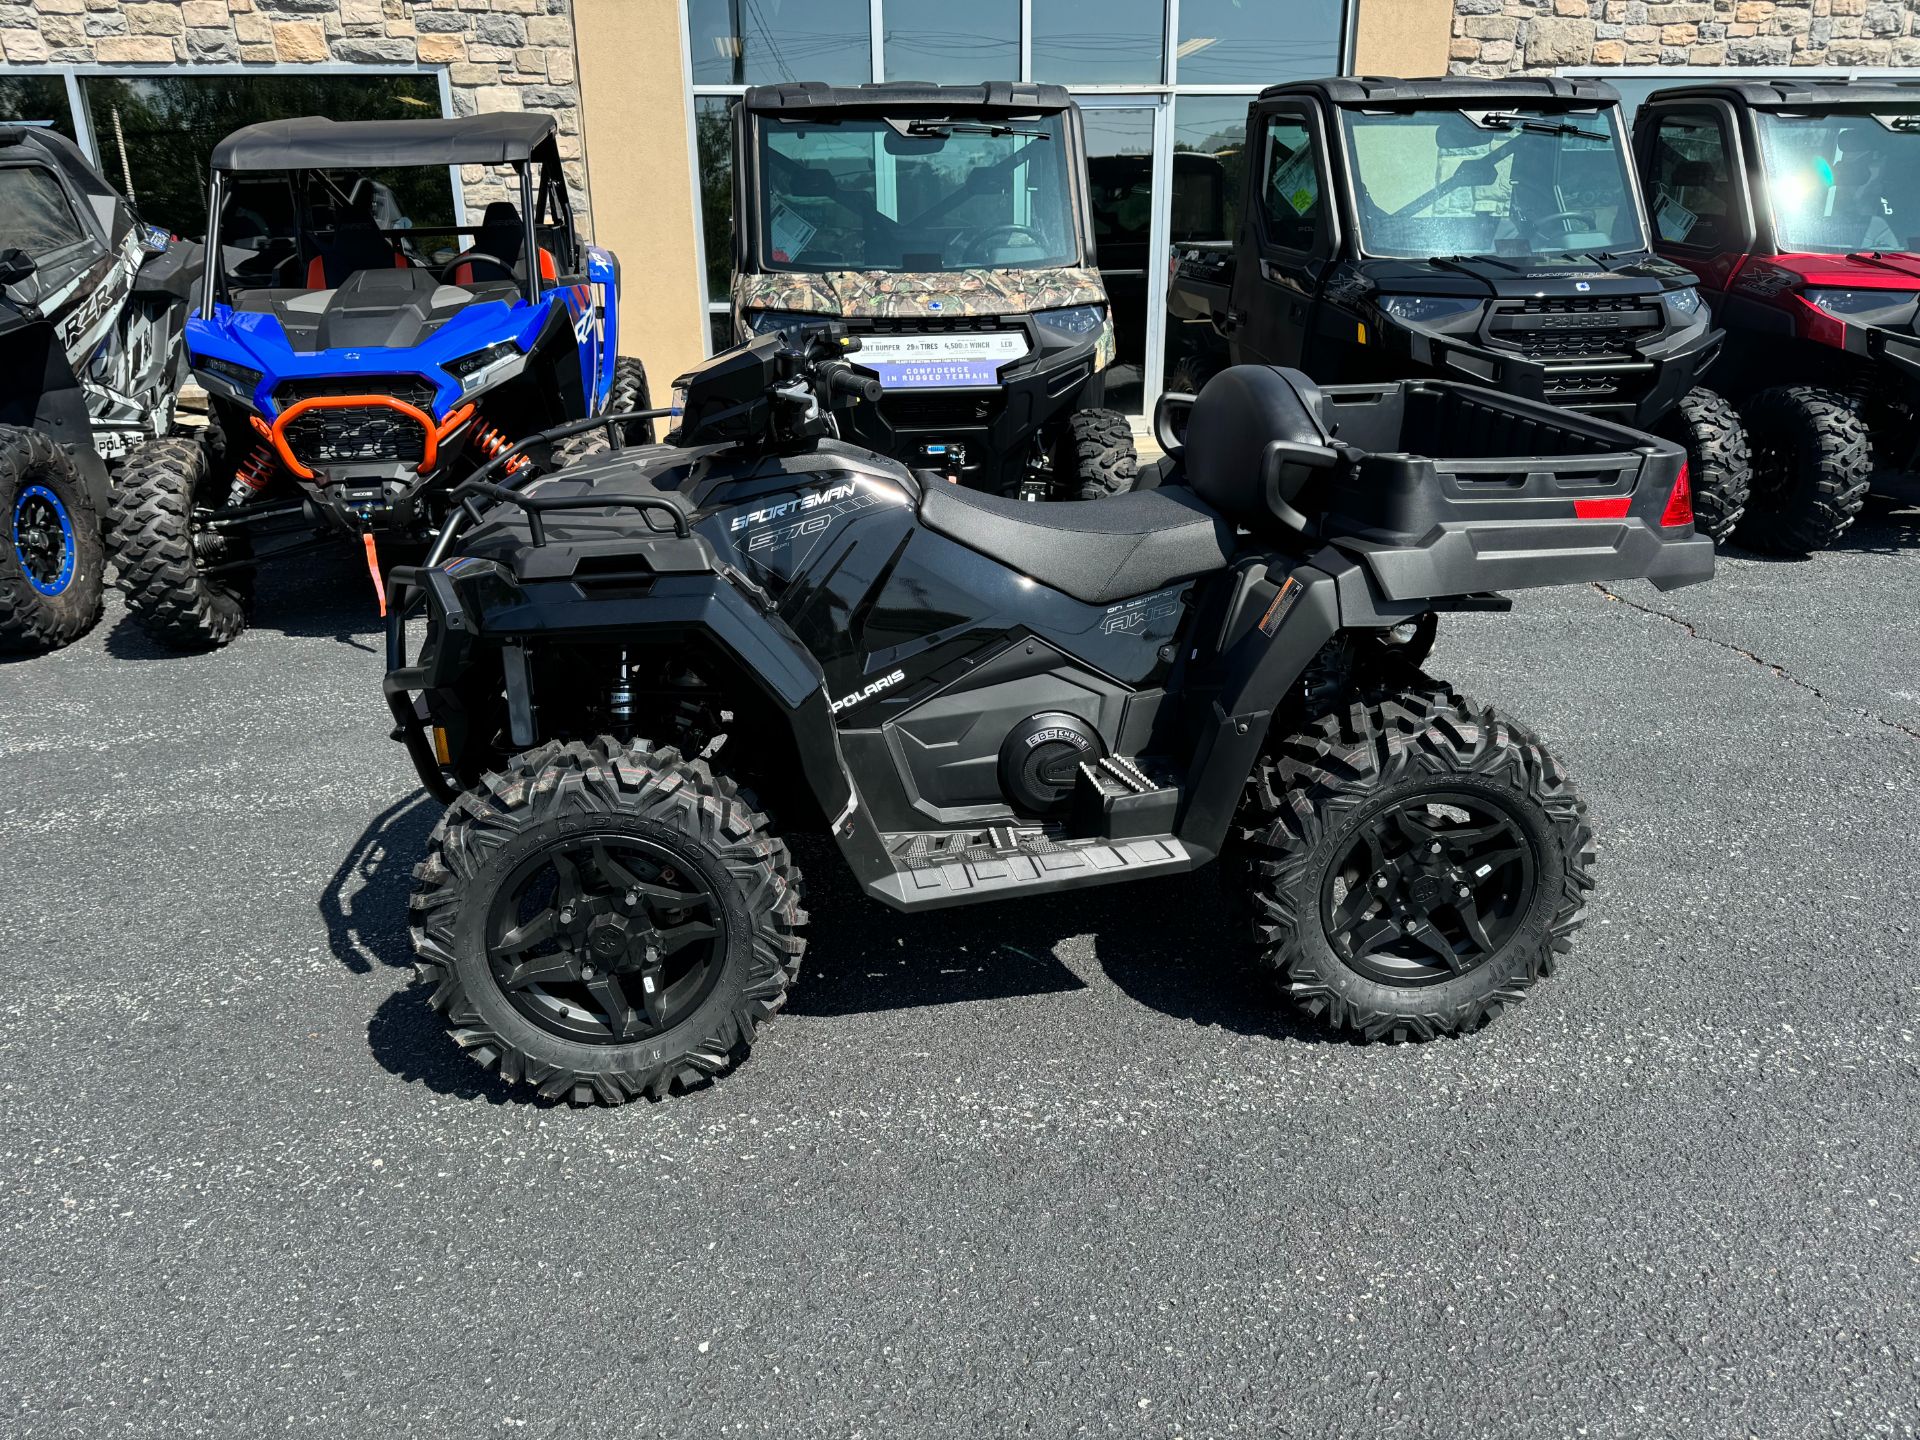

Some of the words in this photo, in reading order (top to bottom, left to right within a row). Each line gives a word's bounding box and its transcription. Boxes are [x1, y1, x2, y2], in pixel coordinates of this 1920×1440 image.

[63, 284, 113, 350] RZR
[1541, 316, 1619, 328] POLARIS
[969, 341, 990, 349] WINCH
[1000, 340, 1013, 348] LED
[902, 373, 941, 382] RUGGED
[945, 372, 990, 381] TERRAIN
[906, 366, 970, 375] CONFIDENCE
[98, 435, 144, 453] POLARIS
[730, 482, 857, 532] SPORTSMAN
[748, 514, 831, 552] 570
[1104, 599, 1178, 635] AWD
[831, 669, 906, 714] POLARIS
[1029, 730, 1056, 745] EBS
[1058, 730, 1088, 748] ENGINE
